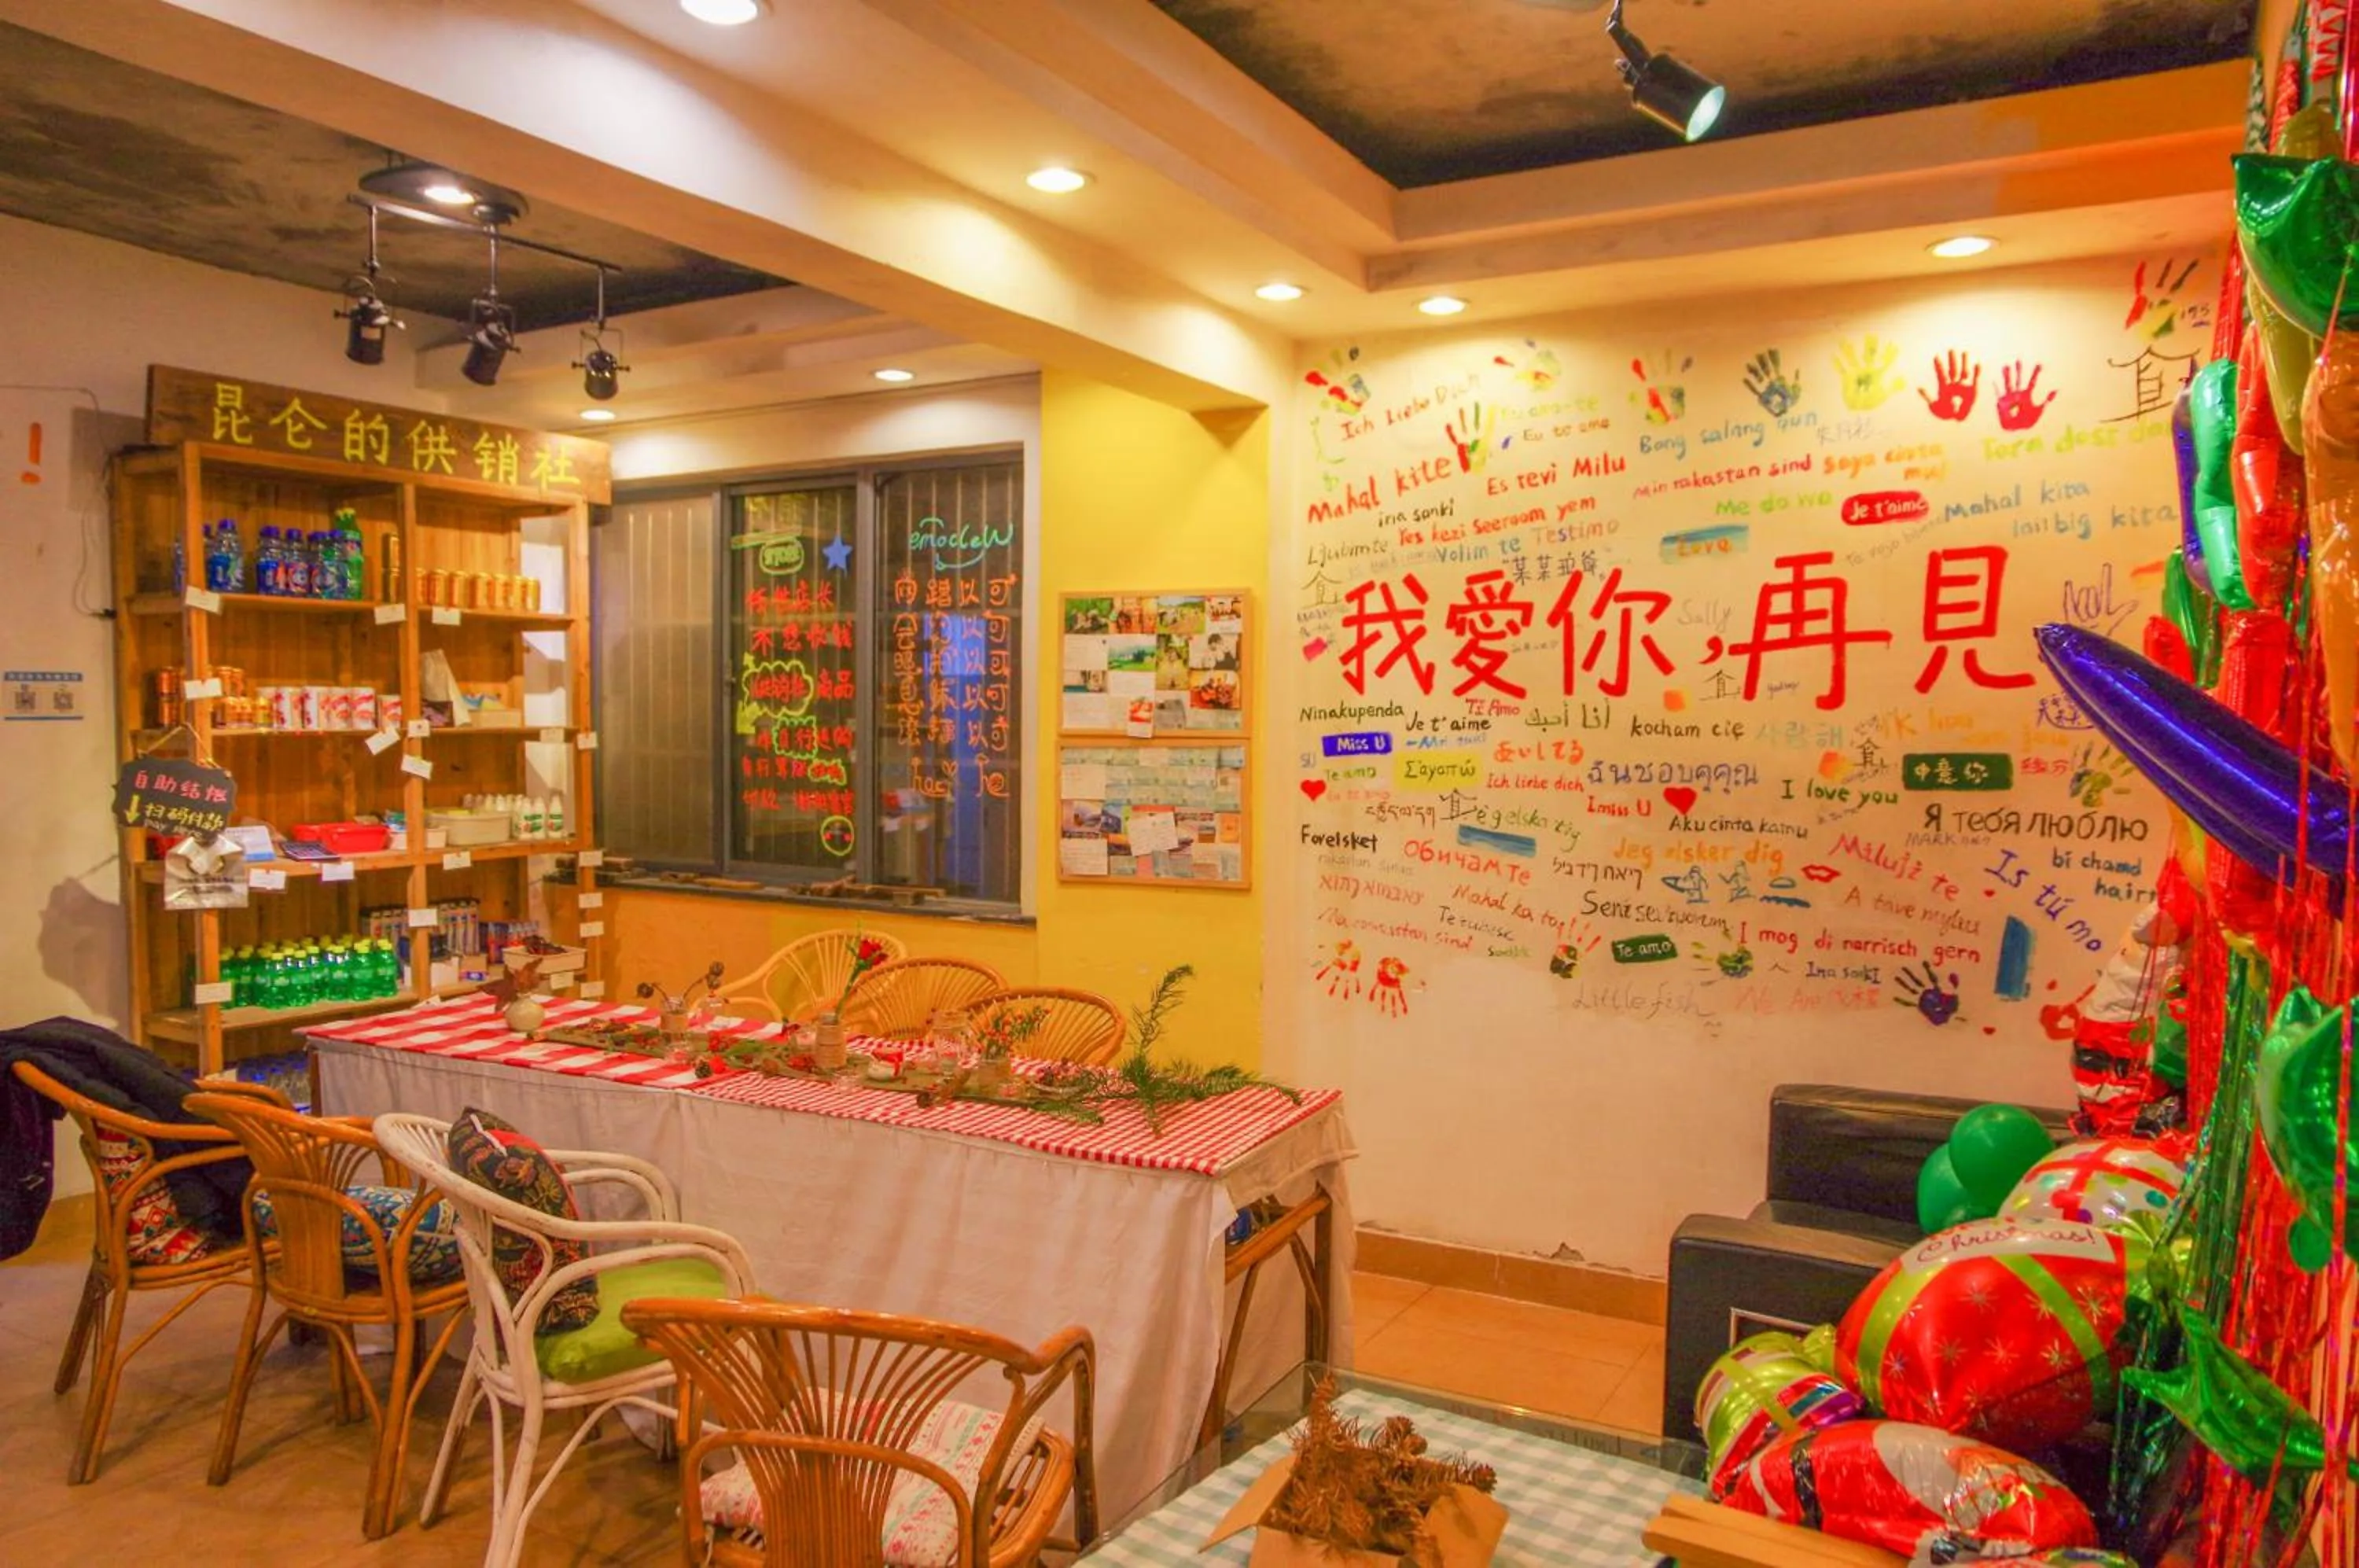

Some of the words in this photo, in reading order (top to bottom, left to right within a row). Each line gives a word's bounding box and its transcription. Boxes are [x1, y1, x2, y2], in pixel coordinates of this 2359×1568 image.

[212, 381, 582, 489] 昆仑的供销社
[1572, 452, 1626, 479] Milu
[1308, 476, 1382, 525] Mahal
[1850, 501, 1868, 520] Je
[1397, 526, 1425, 548] Yes
[1300, 700, 1404, 724] Ninakupenda
[1406, 711, 1425, 732] Je
[1630, 715, 1701, 738] kocham
[1337, 737, 1369, 752] Miss
[1375, 735, 1386, 750] U
[1780, 778, 1795, 800] I
[1806, 778, 1850, 801] love
[1858, 790, 1898, 809] you
[1636, 799, 1651, 817] U
[1669, 815, 1708, 832] Aku
[1923, 803, 1941, 833] Я
[2026, 810, 2148, 842] люблю
[1758, 929, 1799, 954] mog
[1933, 944, 1981, 967] gern
